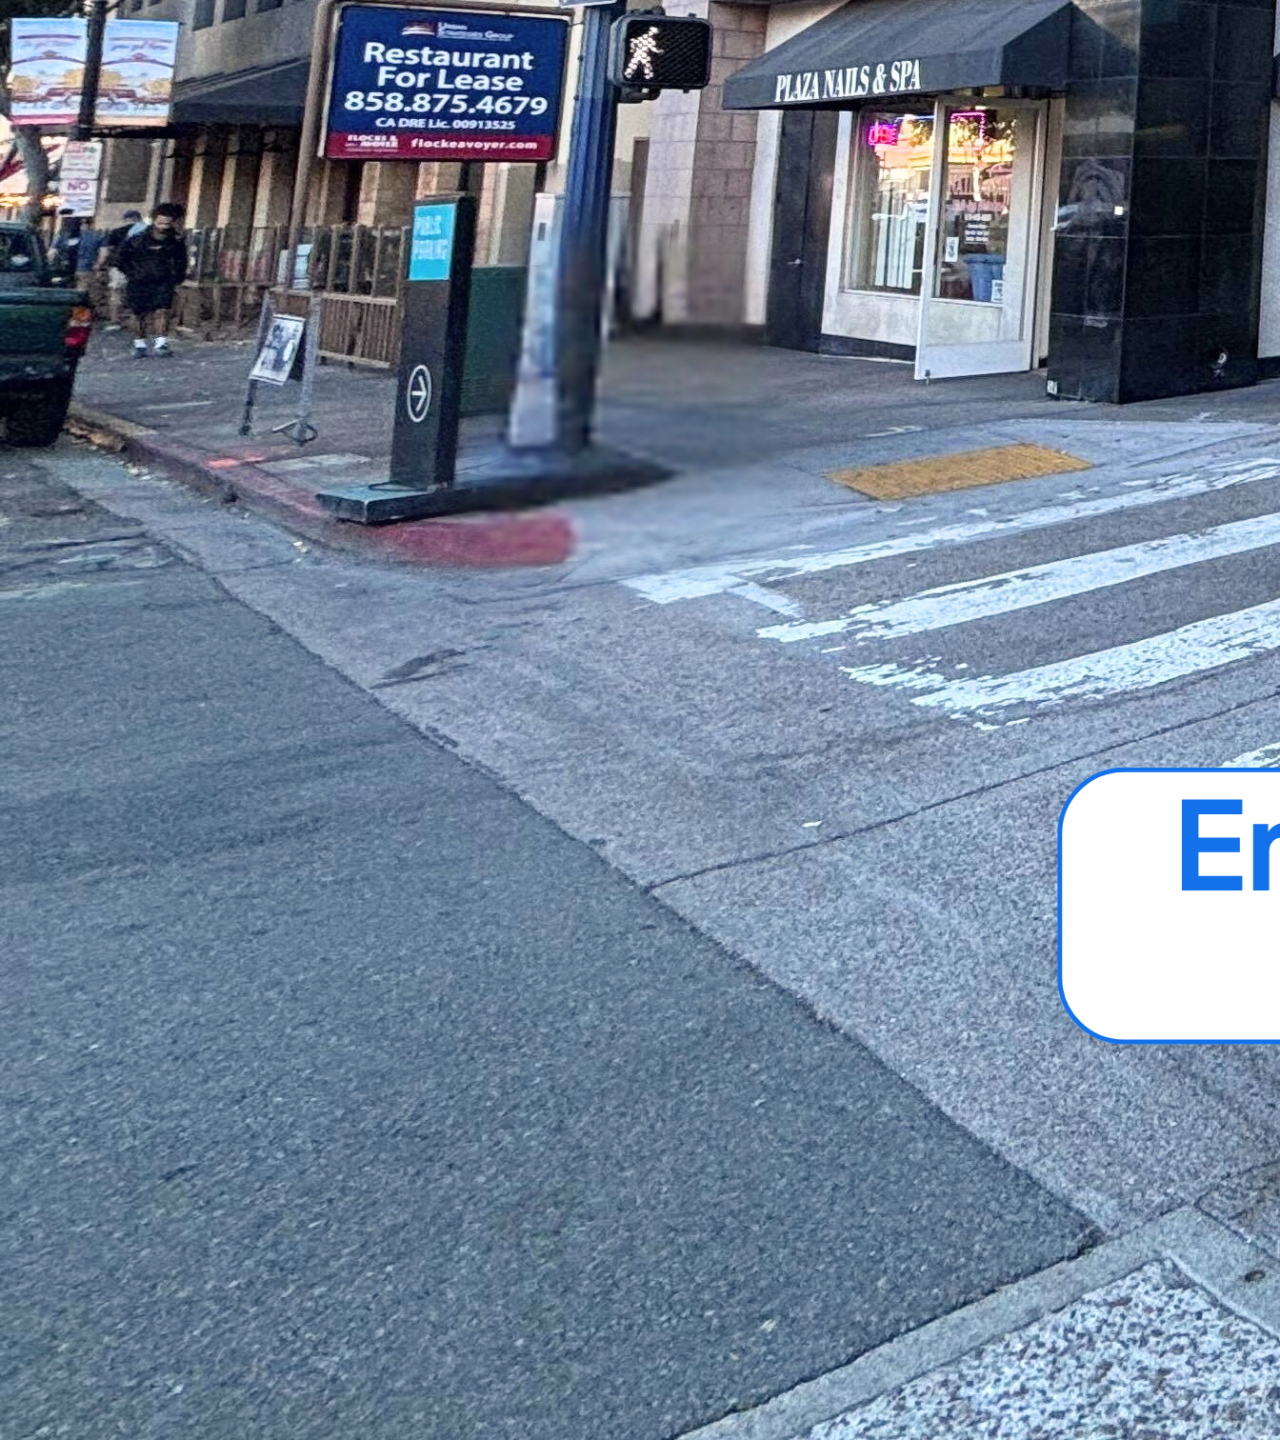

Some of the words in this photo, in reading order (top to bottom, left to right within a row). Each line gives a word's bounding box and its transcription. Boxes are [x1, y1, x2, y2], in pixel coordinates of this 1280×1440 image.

[364, 42, 535, 70] Restaurant
[377, 66, 432, 89] For
[437, 68, 525, 91] Lease
[774, 71, 820, 103] PLAZA
[822, 64, 870, 99] NAILS
[872, 63, 887, 94] &
[889, 59, 921, 92] SPA
[344, 90, 548, 116] 858.875.4679
[375, 117, 396, 128] CA
[398, 117, 427, 128] DRE
[452, 119, 516, 130] 00913525
[410, 138, 538, 151] flockeavoyer.com
[67, 181, 90, 192] NO
